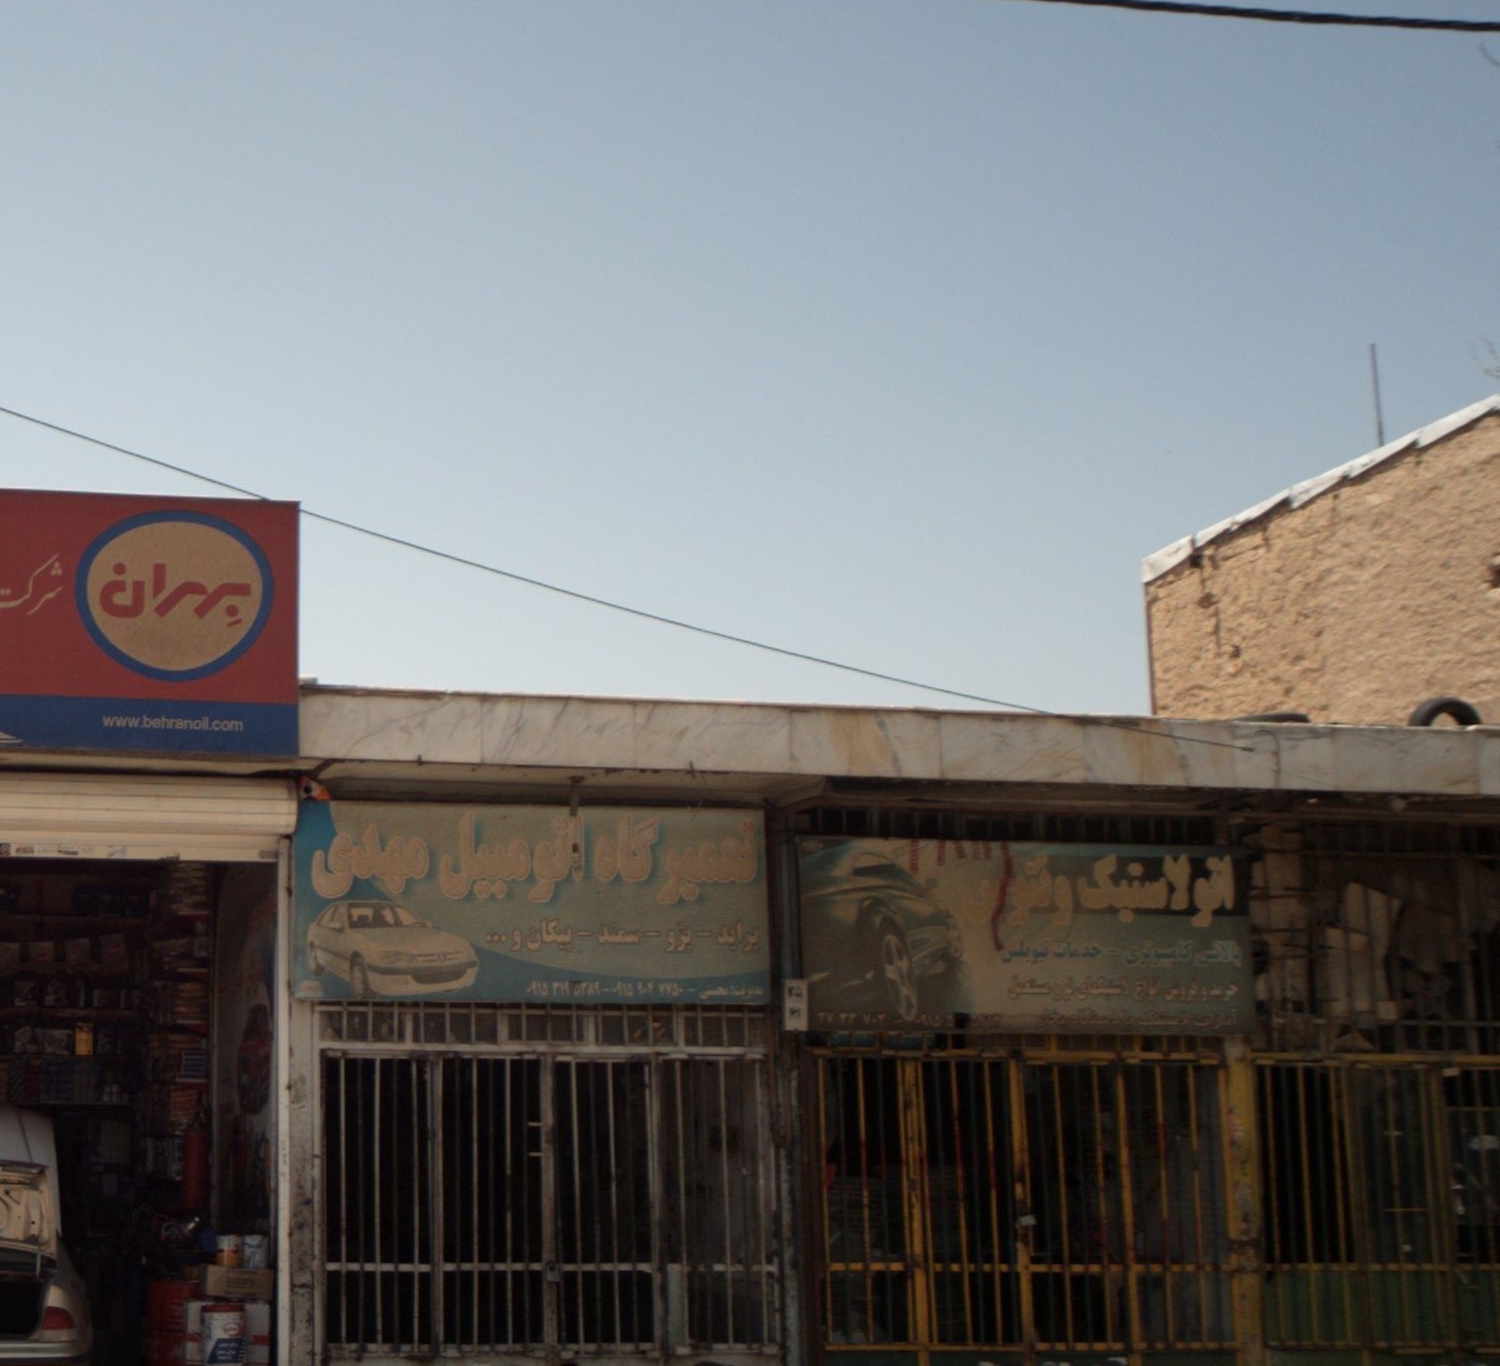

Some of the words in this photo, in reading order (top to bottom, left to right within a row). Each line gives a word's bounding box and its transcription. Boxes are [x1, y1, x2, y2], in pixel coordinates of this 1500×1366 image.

[100, 562, 251, 628] بهران
[102, 714, 244, 732] www.behranoil.com
[311, 822, 430, 899] مهدی
[439, 811, 585, 902] اتومبیل
[526, 917, 574, 952] پیکان
[597, 923, 641, 945] سمند
[665, 921, 693, 953] پژو
